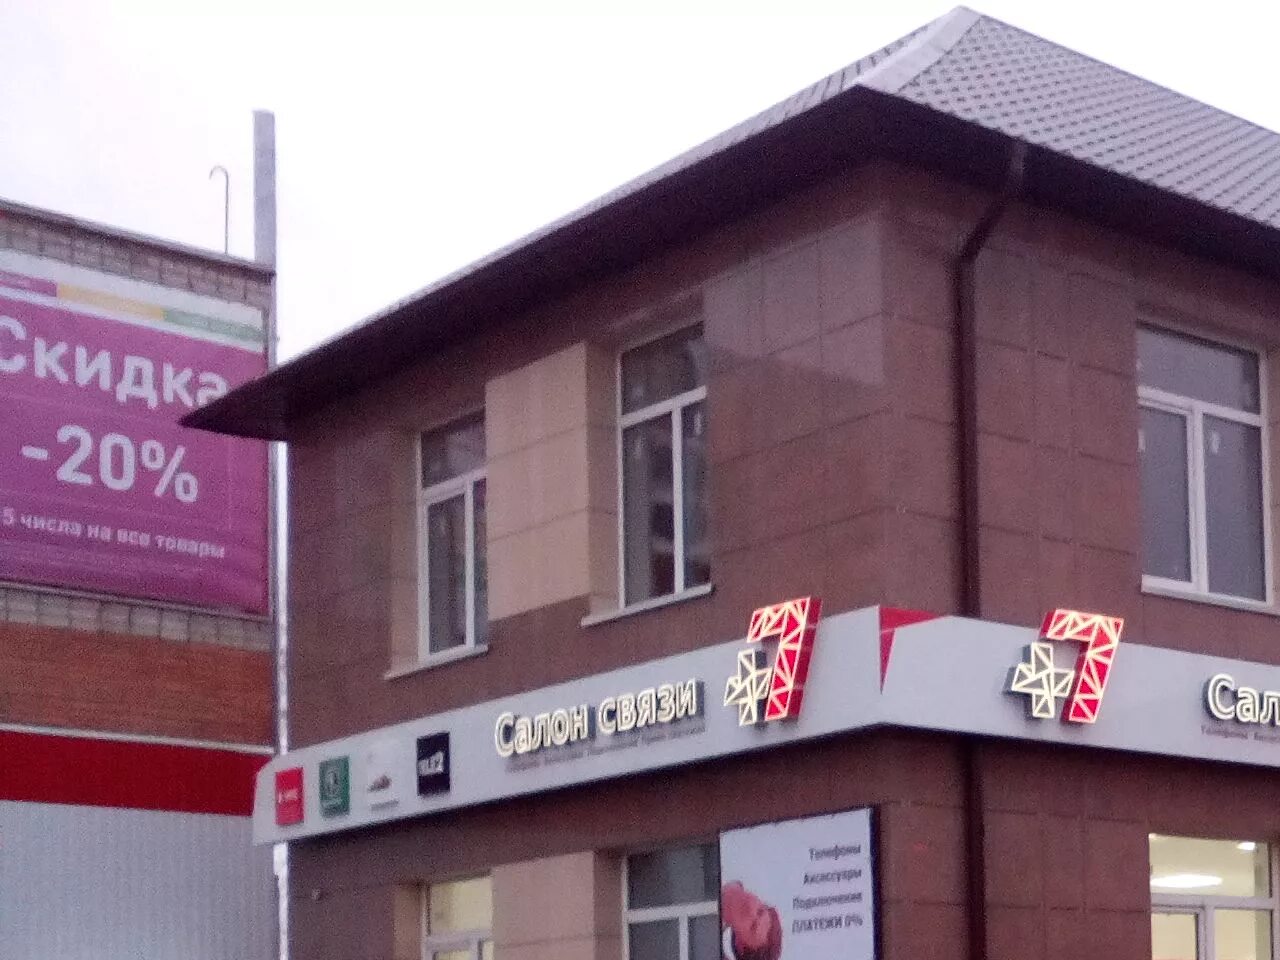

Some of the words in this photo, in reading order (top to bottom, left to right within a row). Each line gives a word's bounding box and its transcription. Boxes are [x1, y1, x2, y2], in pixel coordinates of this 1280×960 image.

[0, 314, 229, 409] Скидка
[20, 425, 199, 503] -20%
[495, 703, 589, 759] Салон
[598, 677, 698, 735] связи
